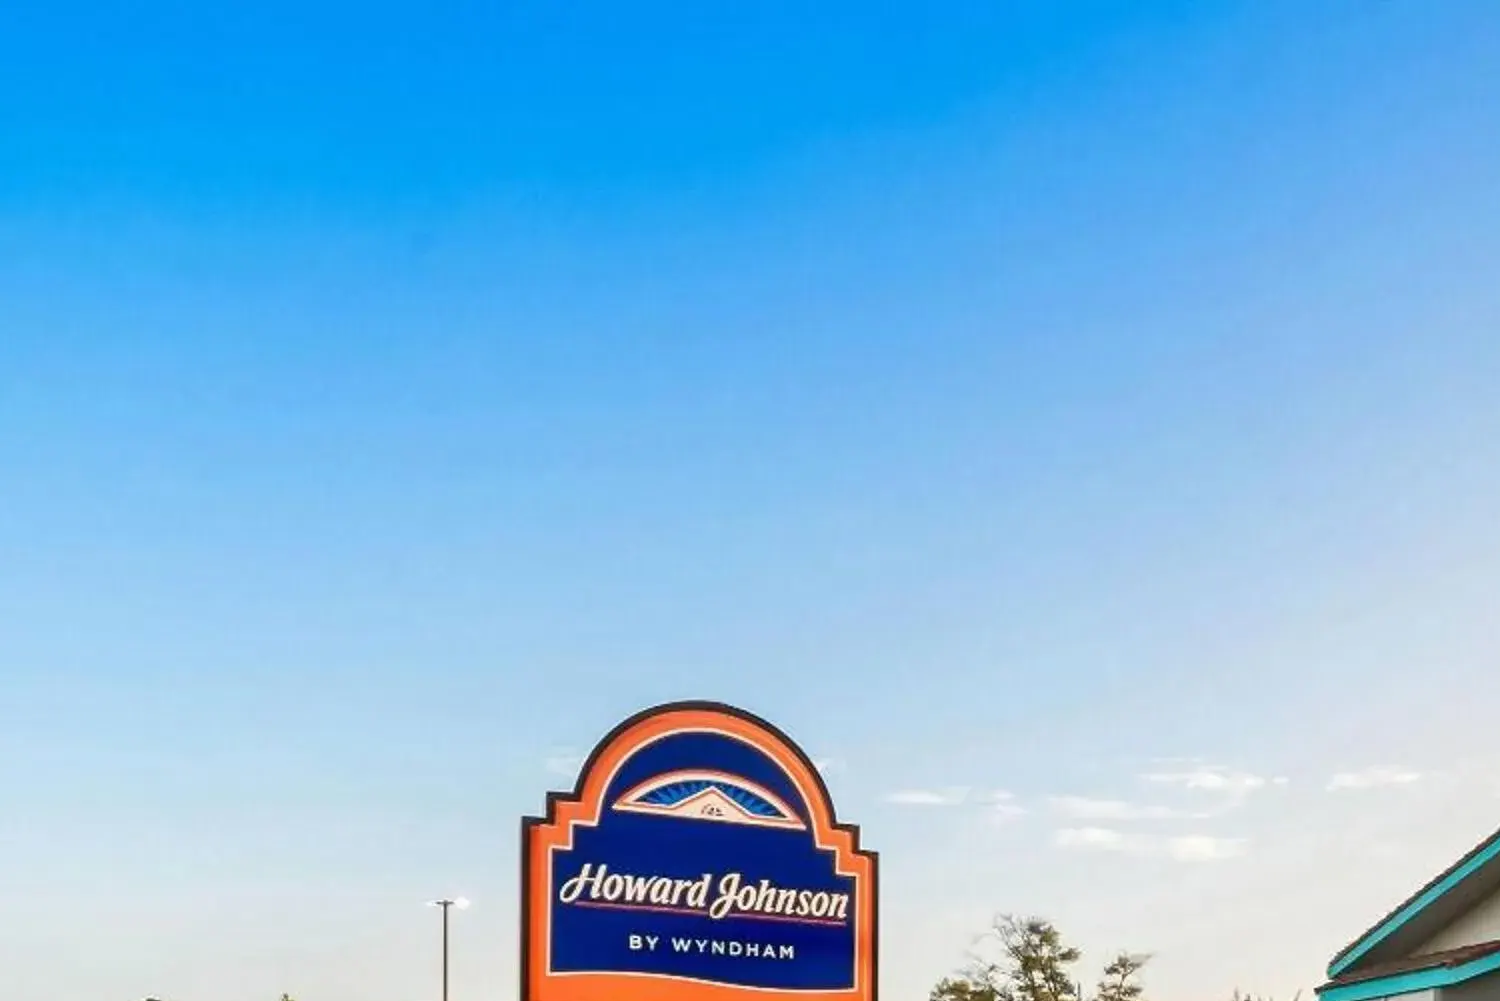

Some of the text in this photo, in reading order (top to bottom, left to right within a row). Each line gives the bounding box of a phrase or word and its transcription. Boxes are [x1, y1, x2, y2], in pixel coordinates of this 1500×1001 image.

[559, 862, 849, 919] Howard Johnson
[629, 934, 795, 959] BY WYNDHAM
